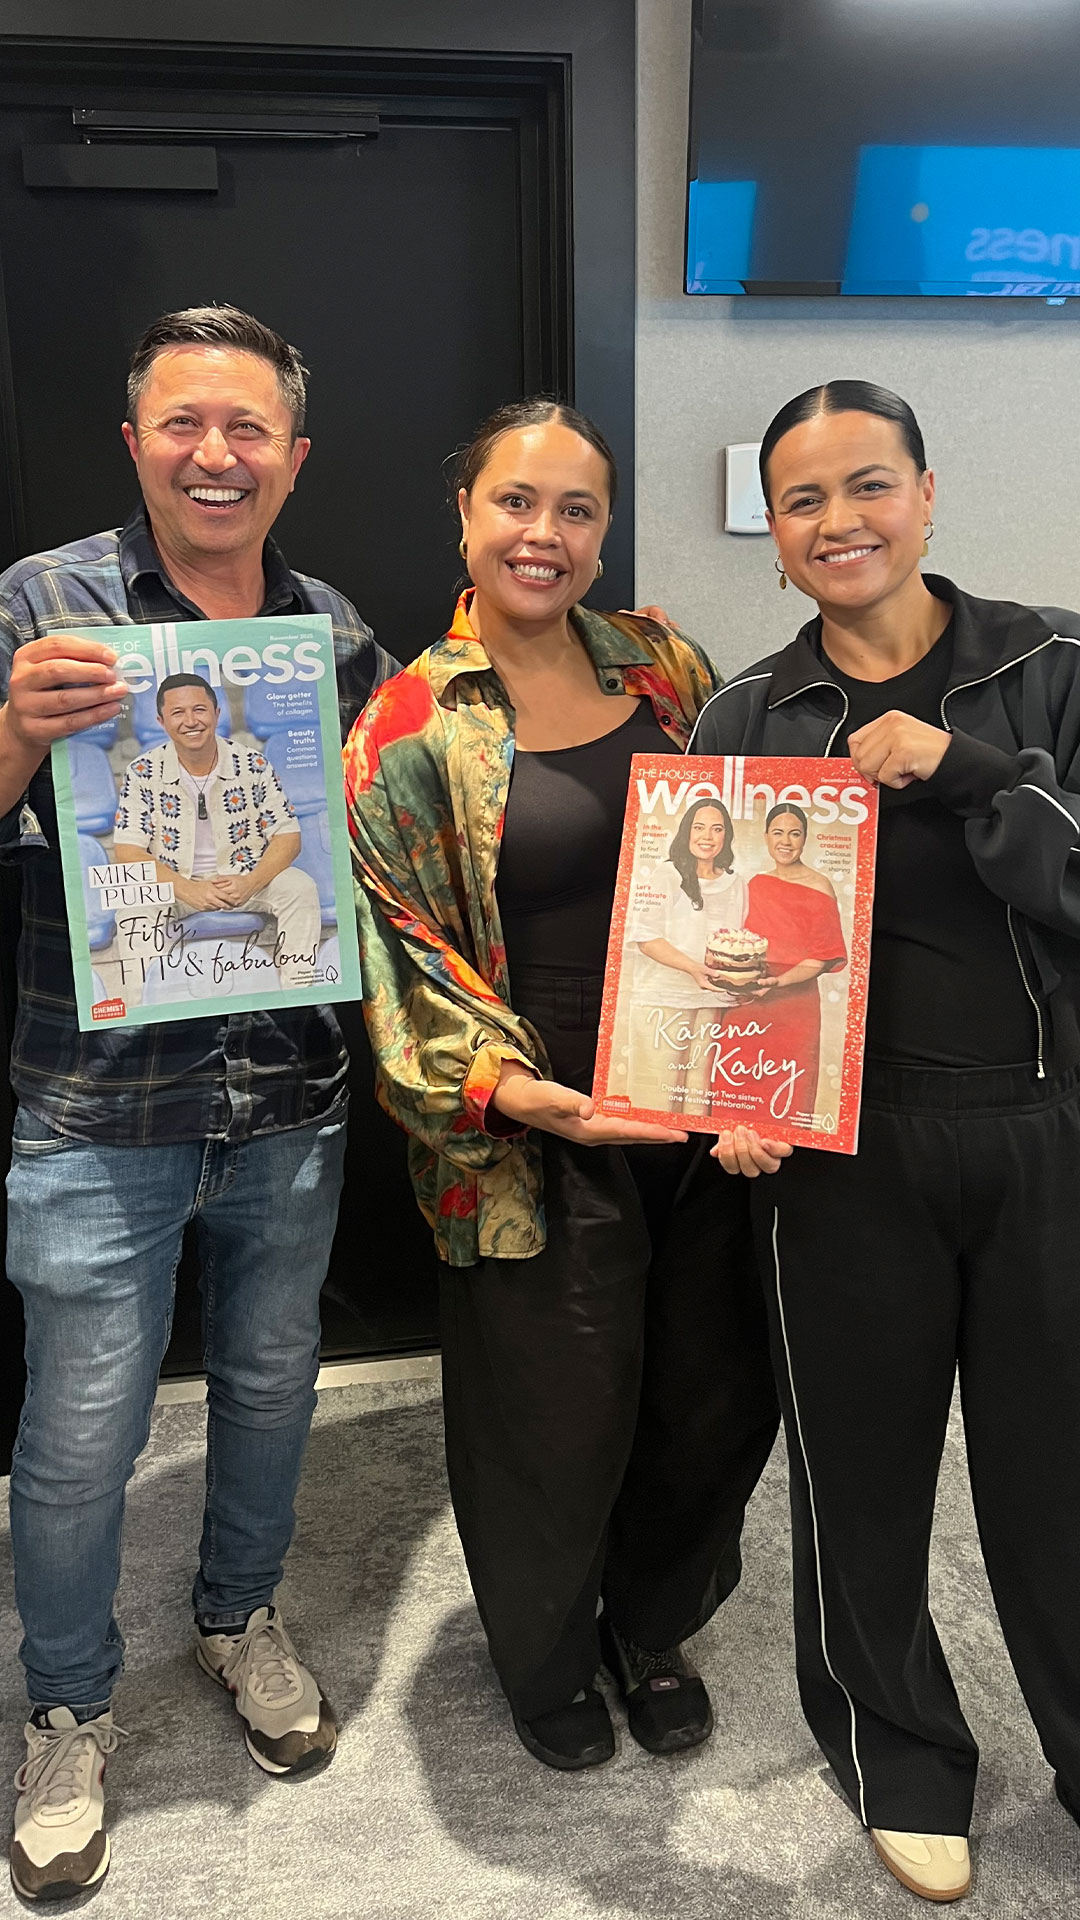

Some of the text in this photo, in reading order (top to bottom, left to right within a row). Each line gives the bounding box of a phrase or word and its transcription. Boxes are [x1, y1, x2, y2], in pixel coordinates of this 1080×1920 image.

[123, 640, 141, 652] OF
[113, 624, 326, 693] ellness
[288, 692, 312, 701] getter
[285, 708, 313, 716] collagen
[287, 729, 315, 738] Beauty
[292, 737, 316, 745] truths
[286, 745, 317, 753] Common
[286, 753, 318, 762] questions
[285, 761, 318, 769] answered
[637, 768, 715, 781] THE HOUSE OF
[816, 834, 852, 842] Christmas
[92, 862, 155, 886] MIKE
[104, 883, 173, 907] PURU
[118, 906, 197, 968] Fifty,
[119, 929, 318, 985] FIT & fabulous
[93, 1004, 124, 1014] CHEMIST
[667, 1042, 806, 1119] and Kasey
[661, 1083, 765, 1104] Double the joy! Two sisters,
[668, 1094, 757, 1111] one festive celebration
